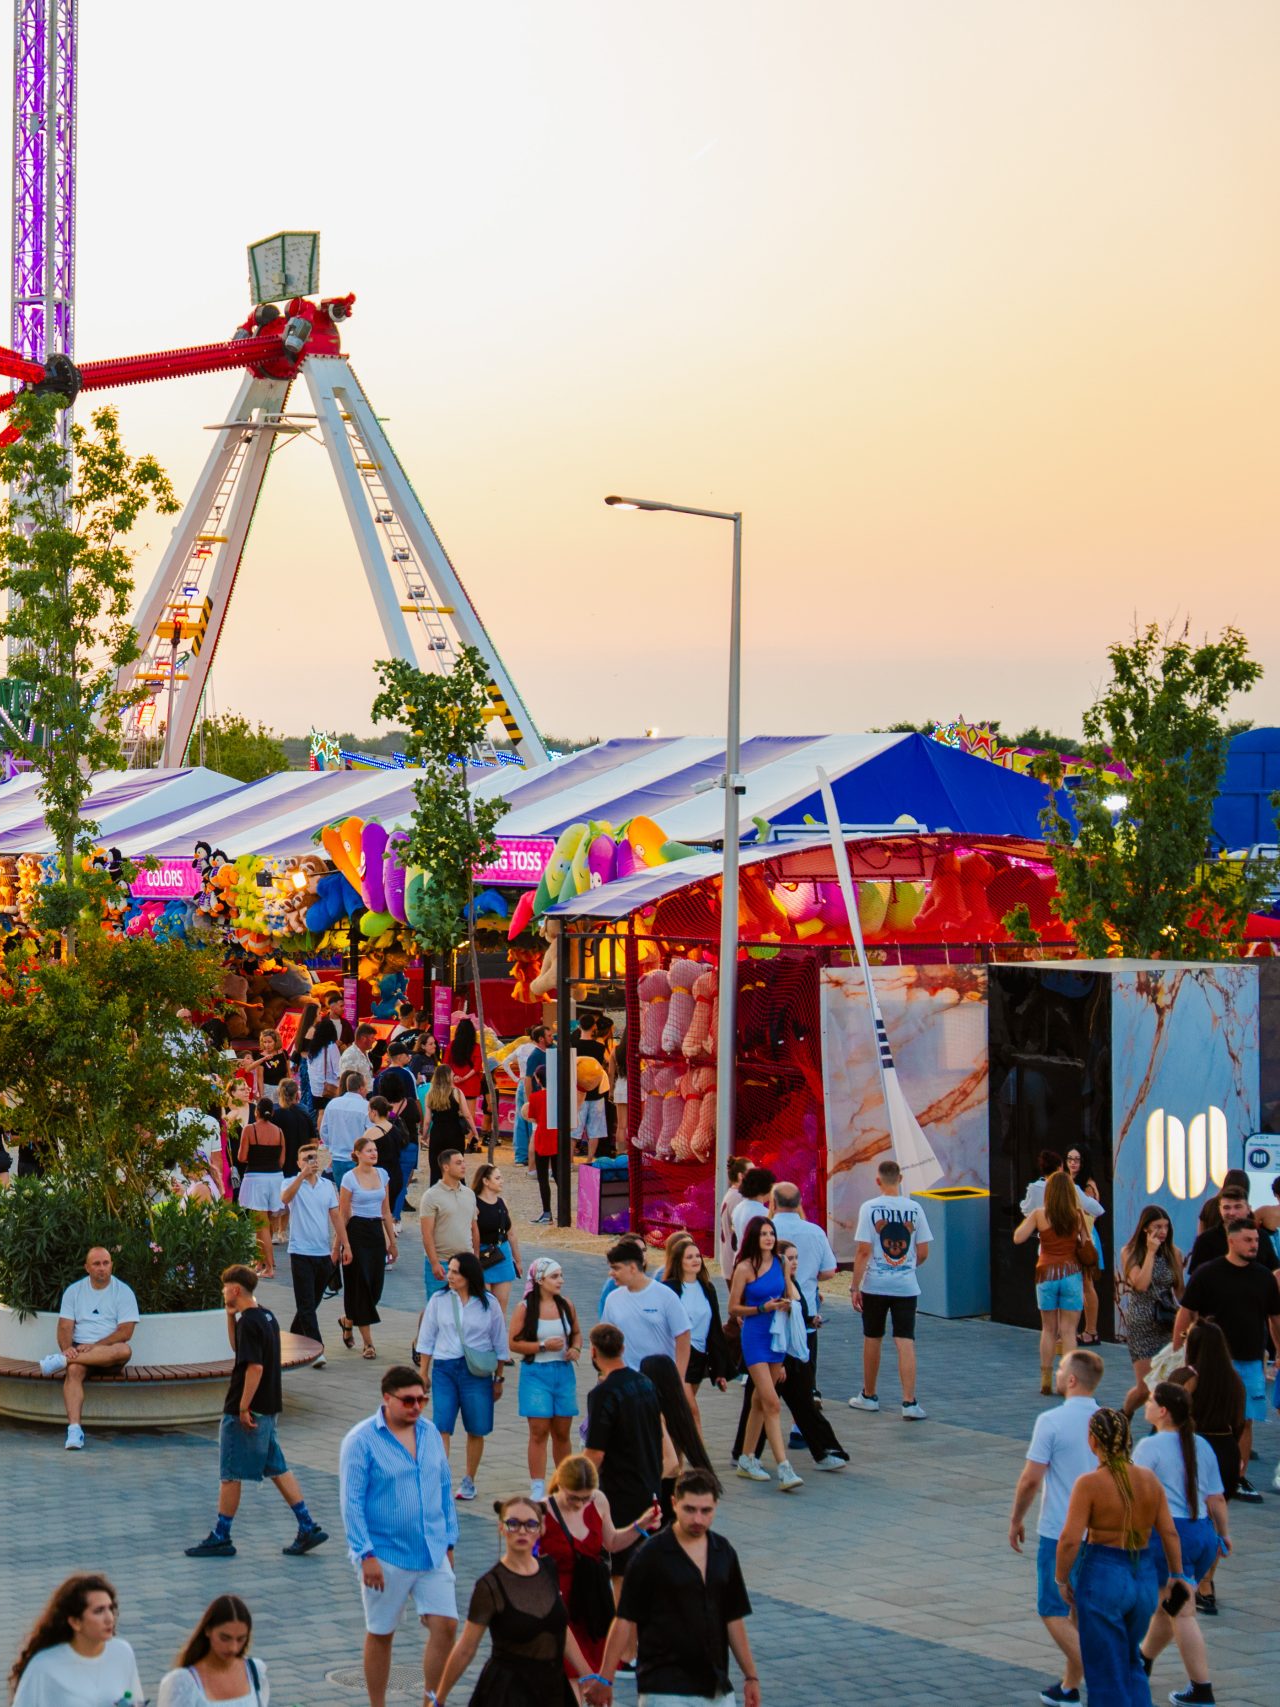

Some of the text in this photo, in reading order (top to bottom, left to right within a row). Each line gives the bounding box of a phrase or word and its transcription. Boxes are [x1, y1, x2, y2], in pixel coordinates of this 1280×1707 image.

[510, 850, 542, 871] TOSS
[146, 869, 183, 887] COLORS
[871, 1208, 918, 1231] CRIME
